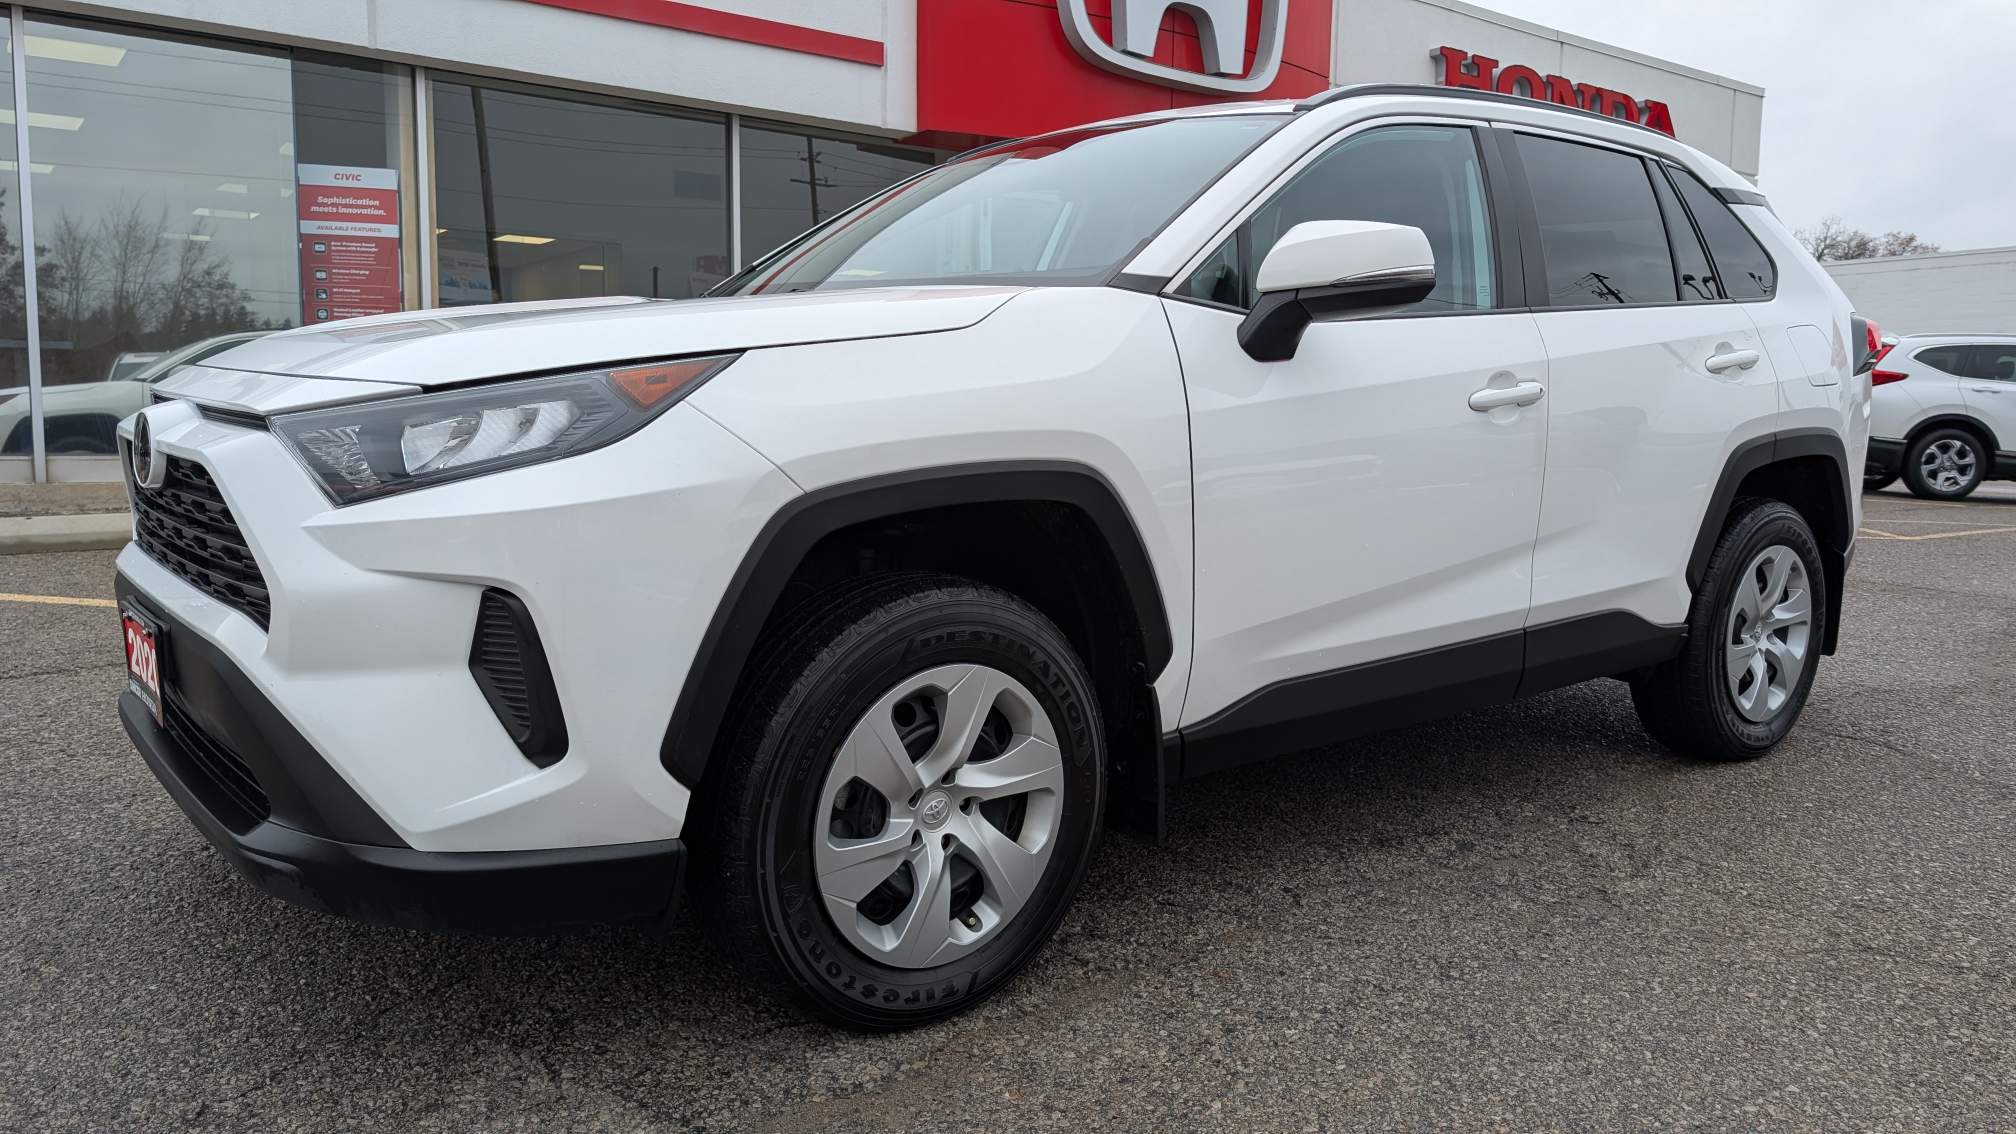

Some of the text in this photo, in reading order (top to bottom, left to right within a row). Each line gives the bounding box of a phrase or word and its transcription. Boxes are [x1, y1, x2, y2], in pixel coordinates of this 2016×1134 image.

[334, 173, 362, 181] CIVIC
[317, 195, 380, 206] Sophistication
[310, 205, 387, 216] meets innovation.
[918, 630, 1090, 749] DESTINATION
